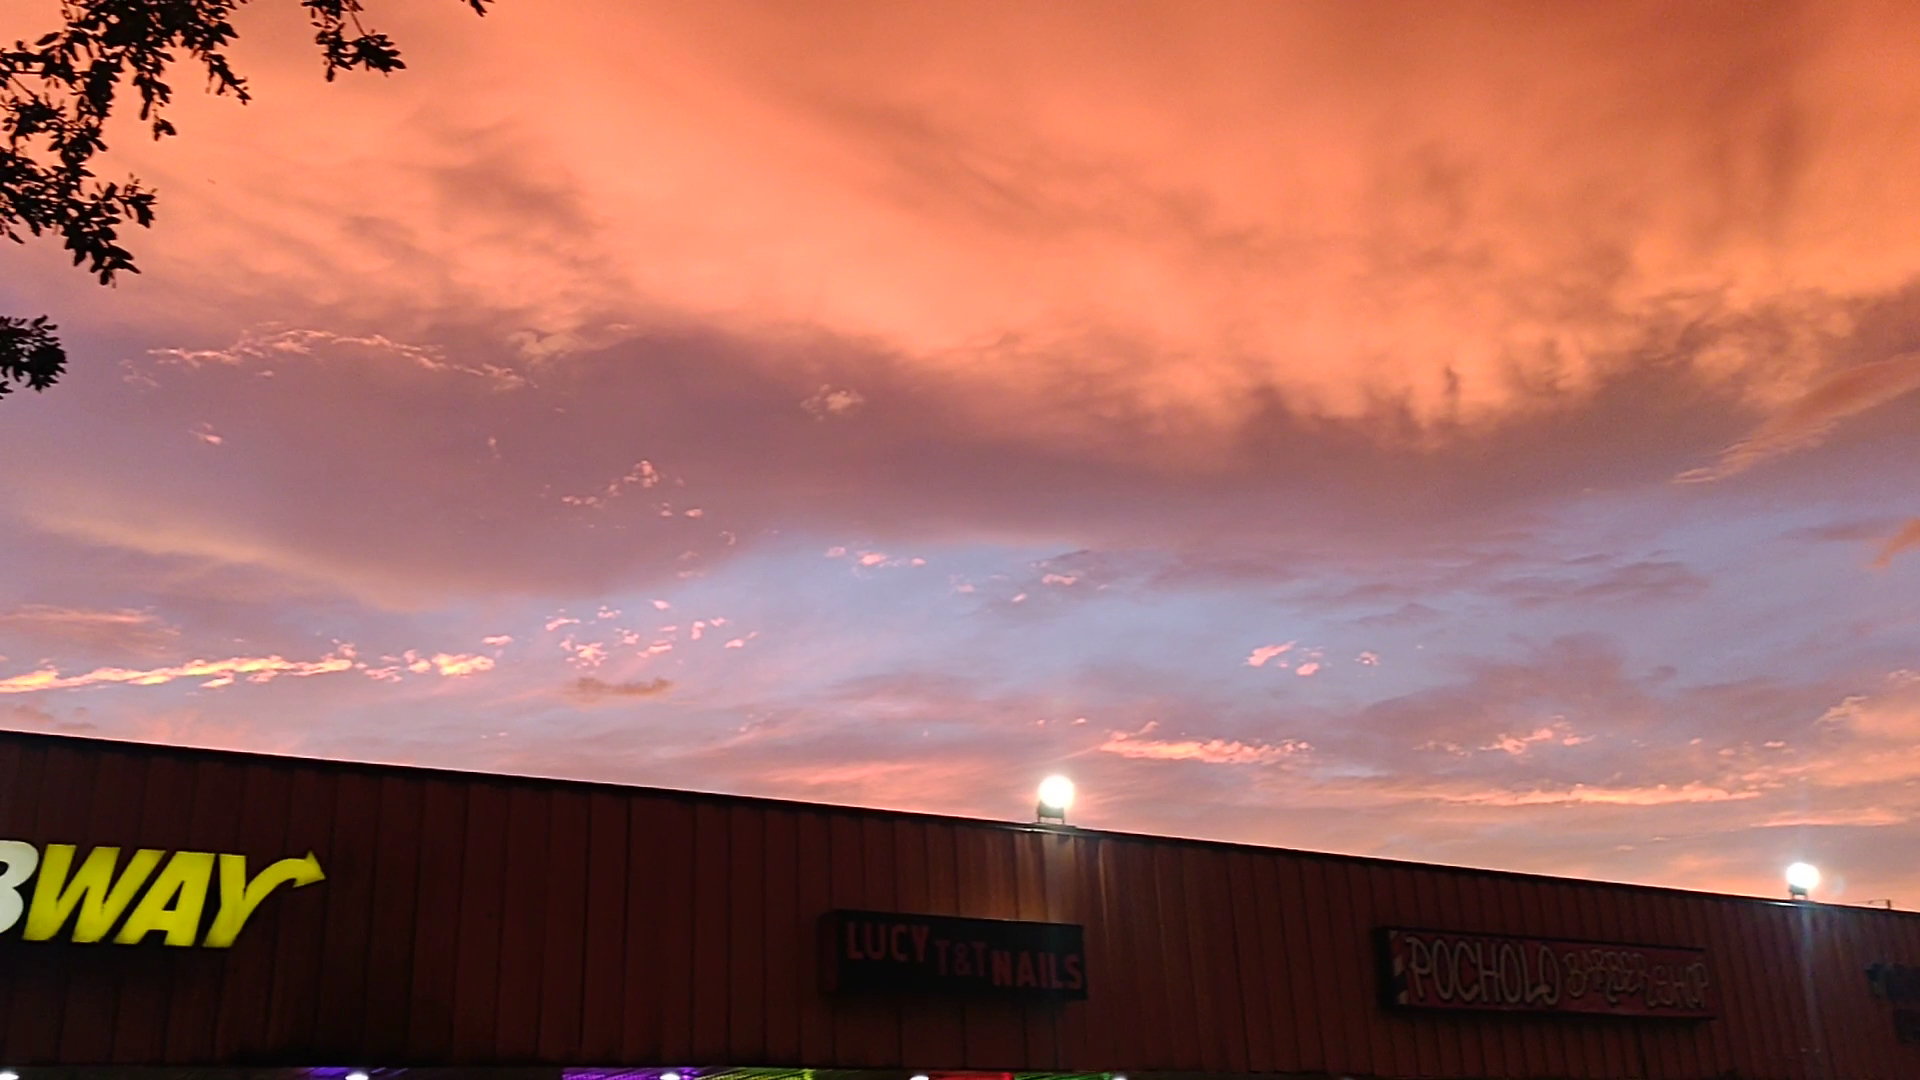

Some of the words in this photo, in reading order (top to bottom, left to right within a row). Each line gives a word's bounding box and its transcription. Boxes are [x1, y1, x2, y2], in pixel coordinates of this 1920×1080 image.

[845, 921, 931, 963] LUCY
[933, 938, 988, 978] T&T
[990, 948, 1084, 991] NAILS
[1404, 935, 1561, 1006] POCHOLO
